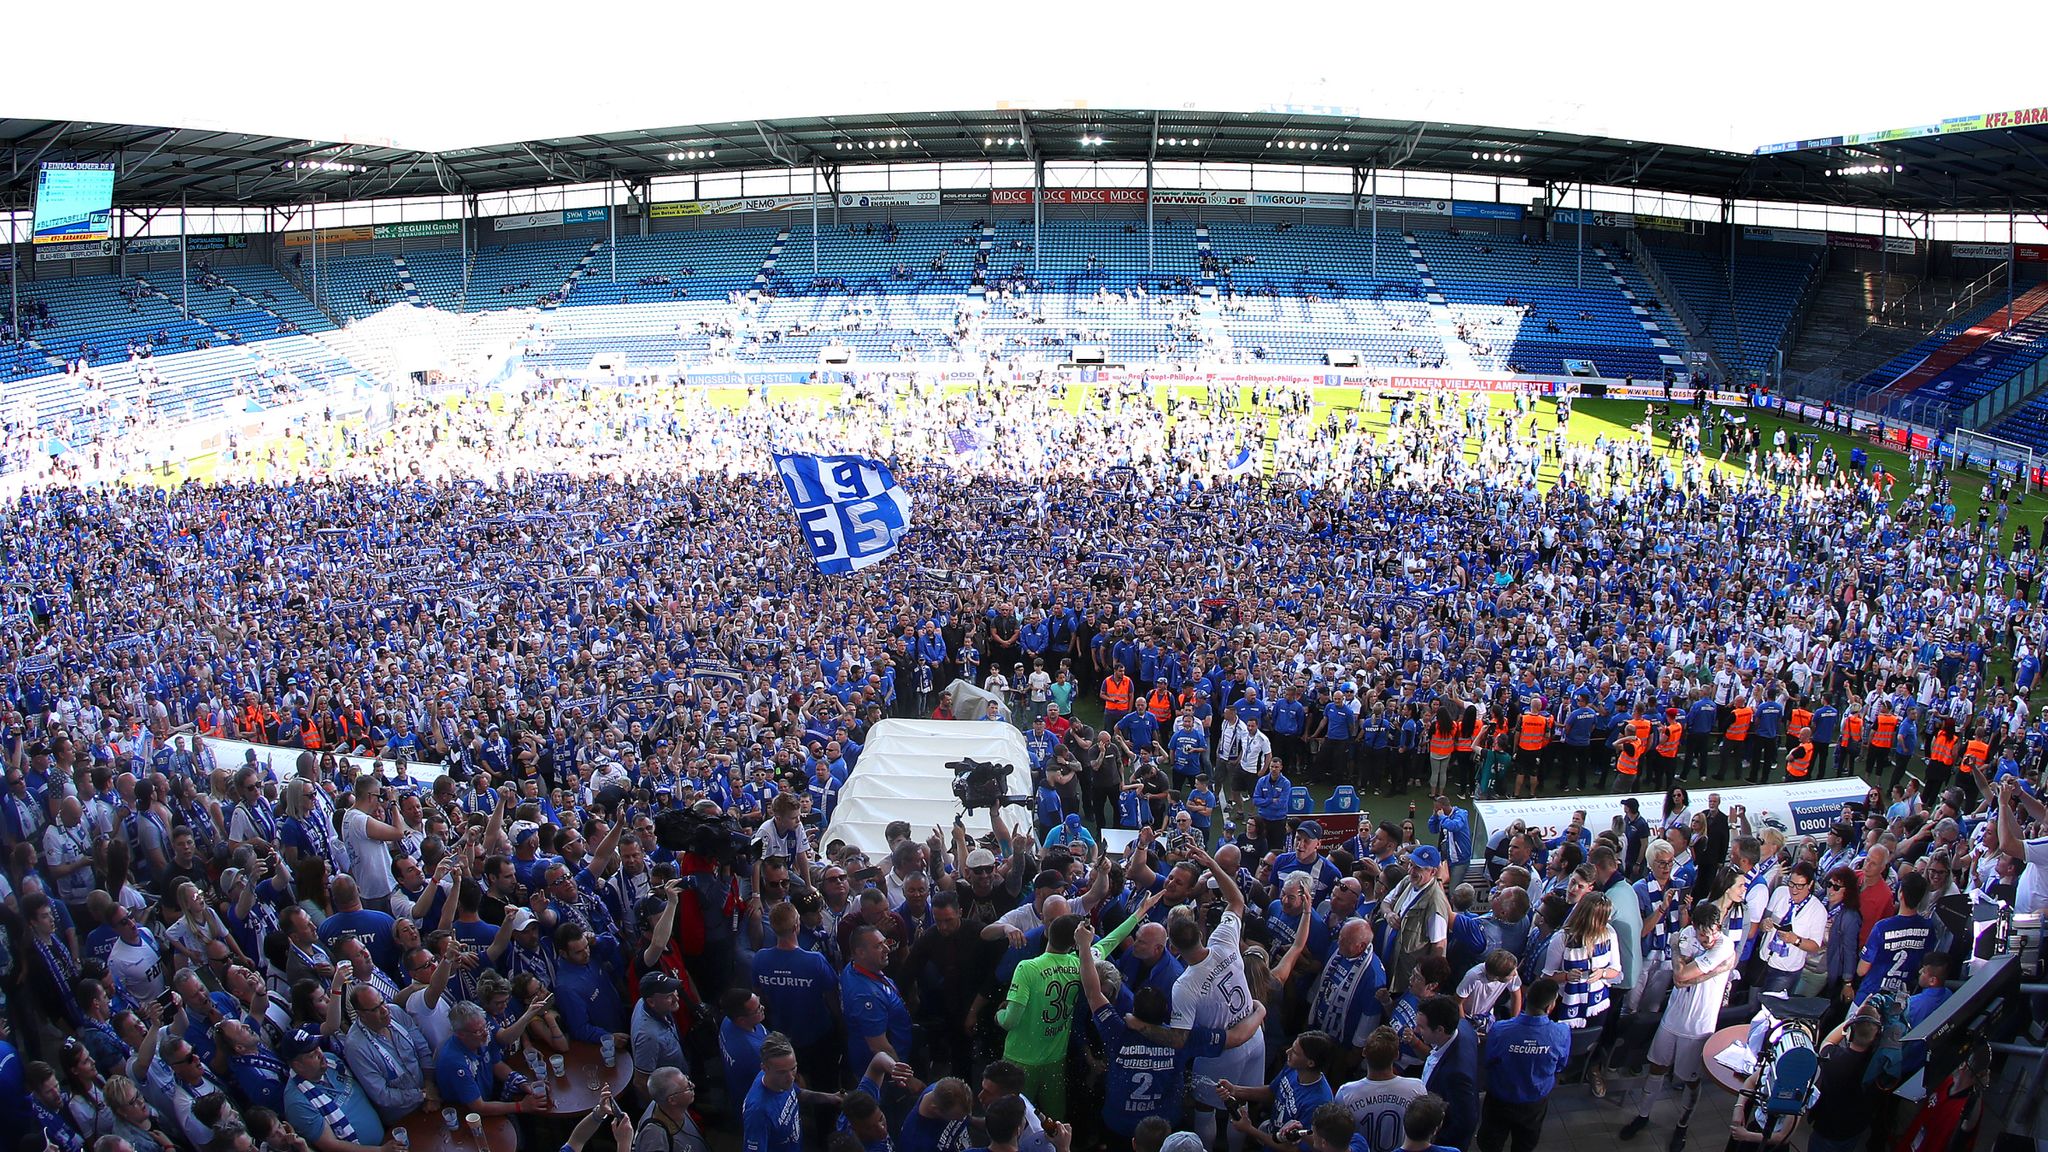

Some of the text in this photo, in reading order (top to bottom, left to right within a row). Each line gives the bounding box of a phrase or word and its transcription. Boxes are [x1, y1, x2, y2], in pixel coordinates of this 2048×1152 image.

[47, 162, 110, 170] EINMAL-IMMER.DE
[992, 191, 1027, 200] MDCC
[1070, 190, 1105, 200] MDCC
[1110, 190, 1144, 200] MDCC
[1257, 195, 1307, 205] TMGROUP
[746, 199, 775, 208] NEMO
[566, 211, 583, 219] SWM
[587, 209, 604, 217] SWM
[398, 222, 459, 233] SEGUIN GmbH
[747, 373, 793, 383] KERSTEN
[1394, 377, 1549, 392] MARKEN VIELFALT AMBIENTE
[831, 461, 870, 499] 9
[800, 501, 892, 558] 6 5
[1484, 804, 1499, 815] 3
[1504, 805, 1547, 814] starke
[1551, 803, 1601, 812] Partner
[1795, 803, 1842, 815] Kostenfreie
[1800, 820, 1827, 831] 0800
[327, 933, 376, 946] SEITY
[1209, 952, 1238, 984] MAGDEBURG
[758, 975, 813, 987] SECURITY
[1217, 970, 1246, 1015] 5
[1042, 980, 1080, 1024] 30
[1508, 1044, 1551, 1055] SECURITY
[1125, 1100, 1155, 1112] LIGA
[1360, 1109, 1401, 1152] 10
